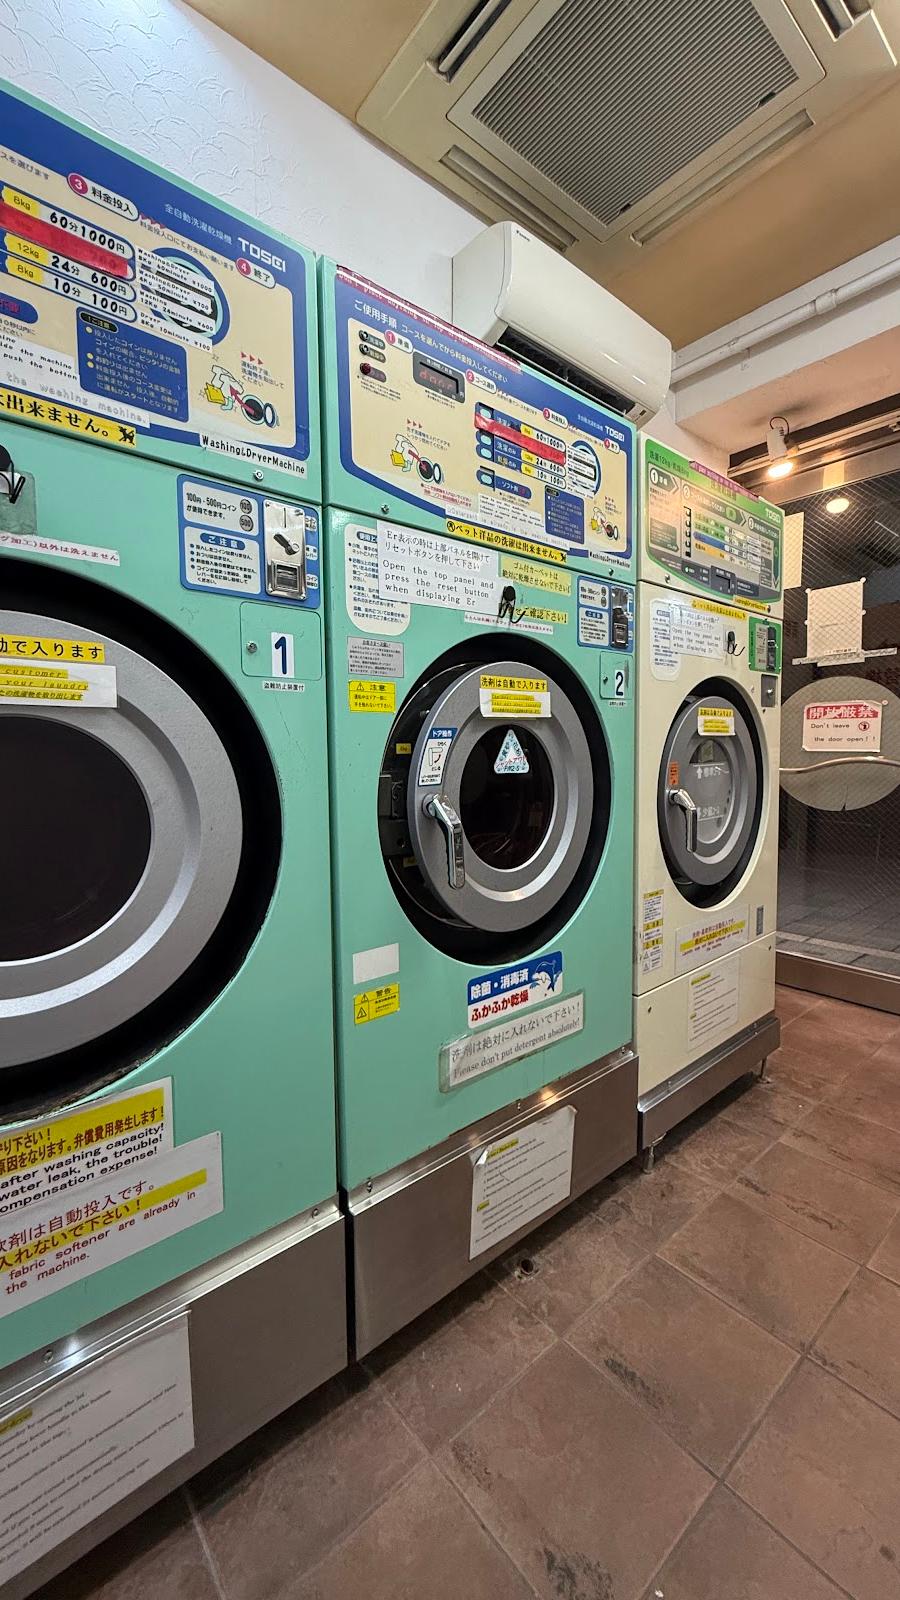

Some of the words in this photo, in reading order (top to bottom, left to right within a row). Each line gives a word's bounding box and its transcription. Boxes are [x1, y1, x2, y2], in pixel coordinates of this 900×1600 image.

[13, 195, 31, 211] 8kg
[74, 178, 83, 190] 3
[91, 186, 134, 216] 料金投入
[50, 211, 79, 233] 60分
[82, 225, 126, 255] 1000円
[16, 242, 40, 259] 12kg
[237, 237, 286, 273] TOSEI
[17, 265, 34, 278] 8kg
[51, 255, 81, 276] 24分
[91, 272, 127, 296] 600円
[253, 267, 271, 284] 終了
[53, 278, 81, 298] 10分
[92, 293, 127, 317] 100円
[354, 299, 398, 329] ご使用手順
[3, 351, 23, 363] push
[604, 425, 625, 442] TOSEI
[208, 535, 239, 548] ご注意
[385, 540, 480, 570] リセットボタンを押して下さい
[386, 530, 491, 564] Er表示の時は上部パネルを開けて
[382, 559, 406, 572] Open
[413, 564, 428, 576] the
[434, 570, 448, 581] top
[454, 575, 476, 586] panel
[480, 580, 494, 590] and
[385, 573, 410, 583] press
[416, 576, 431, 588] the
[437, 582, 458, 593] reset
[464, 587, 489, 599] button
[385, 584, 409, 595] when
[416, 587, 460, 605] displaying
[466, 597, 476, 606] Er
[274, 636, 287, 675] 1
[5, 667, 62, 678] customer
[6, 679, 34, 687] your
[43, 681, 89, 691] laundry
[481, 676, 546, 690] 洗剤は自動で入ります
[615, 671, 624, 696] 2
[809, 705, 873, 720] 開放厳禁
[471, 968, 529, 1001] 除菌・消毒済
[471, 989, 529, 1022] ふかふか乾燥
[453, 1060, 480, 1079] Please
[481, 1052, 500, 1067] don't
[501, 1048, 514, 1060] put
[514, 1033, 547, 1053] detergent
[0, 1169, 39, 1190] after
[44, 1146, 102, 1173] washing
[106, 1122, 165, 1151] capacity!
[85, 1156, 109, 1169] the
[113, 1133, 164, 1159] trouble!
[100, 1146, 158, 1176] expense!
[8, 1258, 46, 1281] fabric
[55, 1229, 111, 1260] softener
[117, 1218, 136, 1232] are
[143, 1198, 181, 1220] already
[186, 1190, 196, 1201] in
[5, 1279, 28, 1296] the
[36, 1252, 91, 1282] machine.
